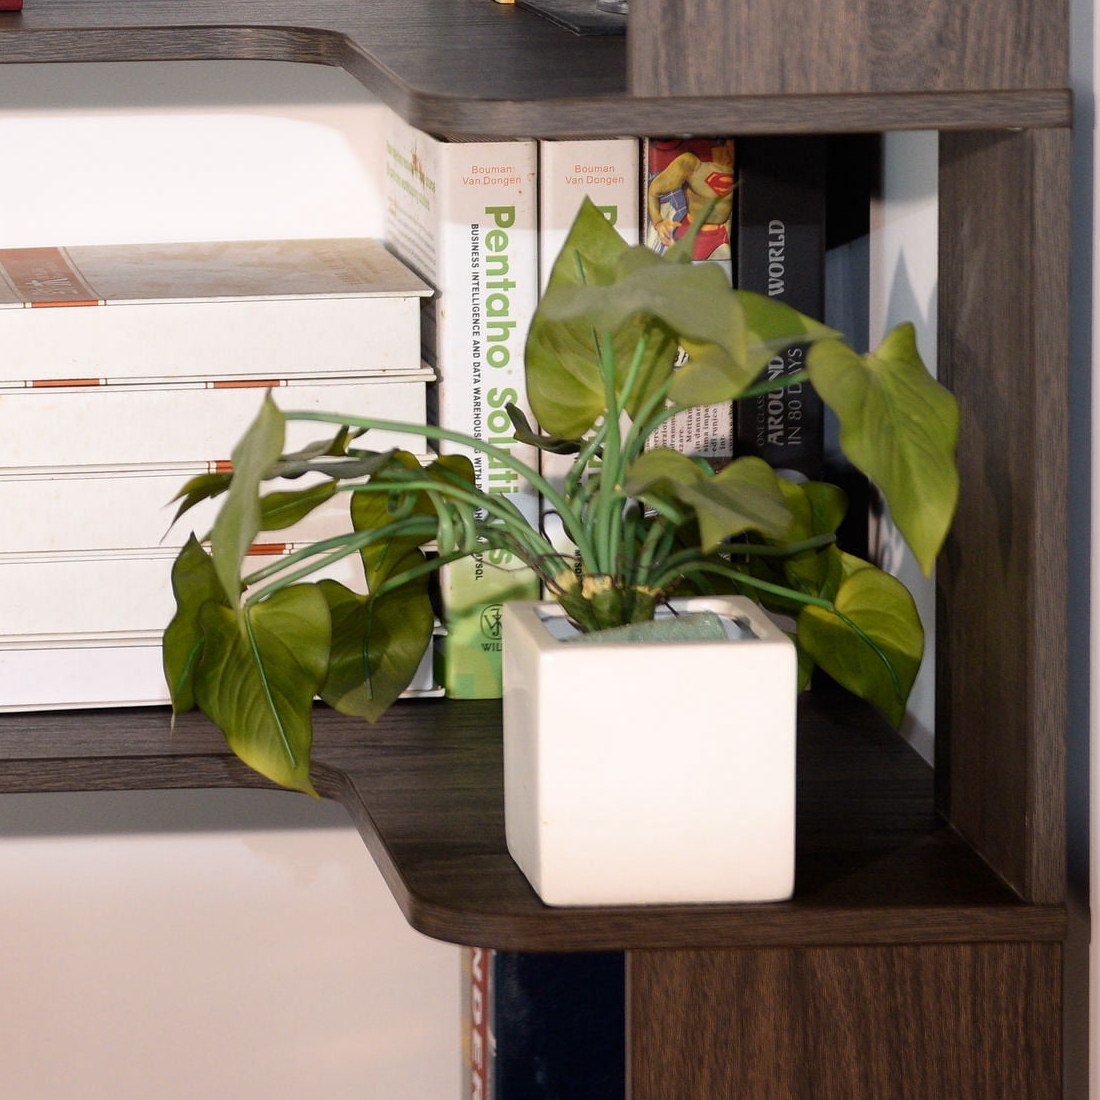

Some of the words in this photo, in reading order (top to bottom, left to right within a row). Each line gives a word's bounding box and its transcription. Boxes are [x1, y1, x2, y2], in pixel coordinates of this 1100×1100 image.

[470, 164, 513, 175] Bouman
[574, 163, 615, 174] Bouman
[462, 175, 482, 186] Van
[484, 175, 522, 188] Dongen
[565, 175, 585, 185] Van
[587, 174, 625, 187] Dongen
[470, 223, 480, 269] BUSINESS
[767, 219, 786, 296] WORLD
[471, 271, 481, 338] INTELLIGENCE
[471, 340, 481, 359] AND
[472, 361, 481, 385] DATA
[787, 399, 803, 420] 80
[472, 386, 483, 454] WAREHOUSIG
[787, 426, 802, 446] IN
[473, 456, 483, 482] WITH
[481, 642, 503, 652] WIL
